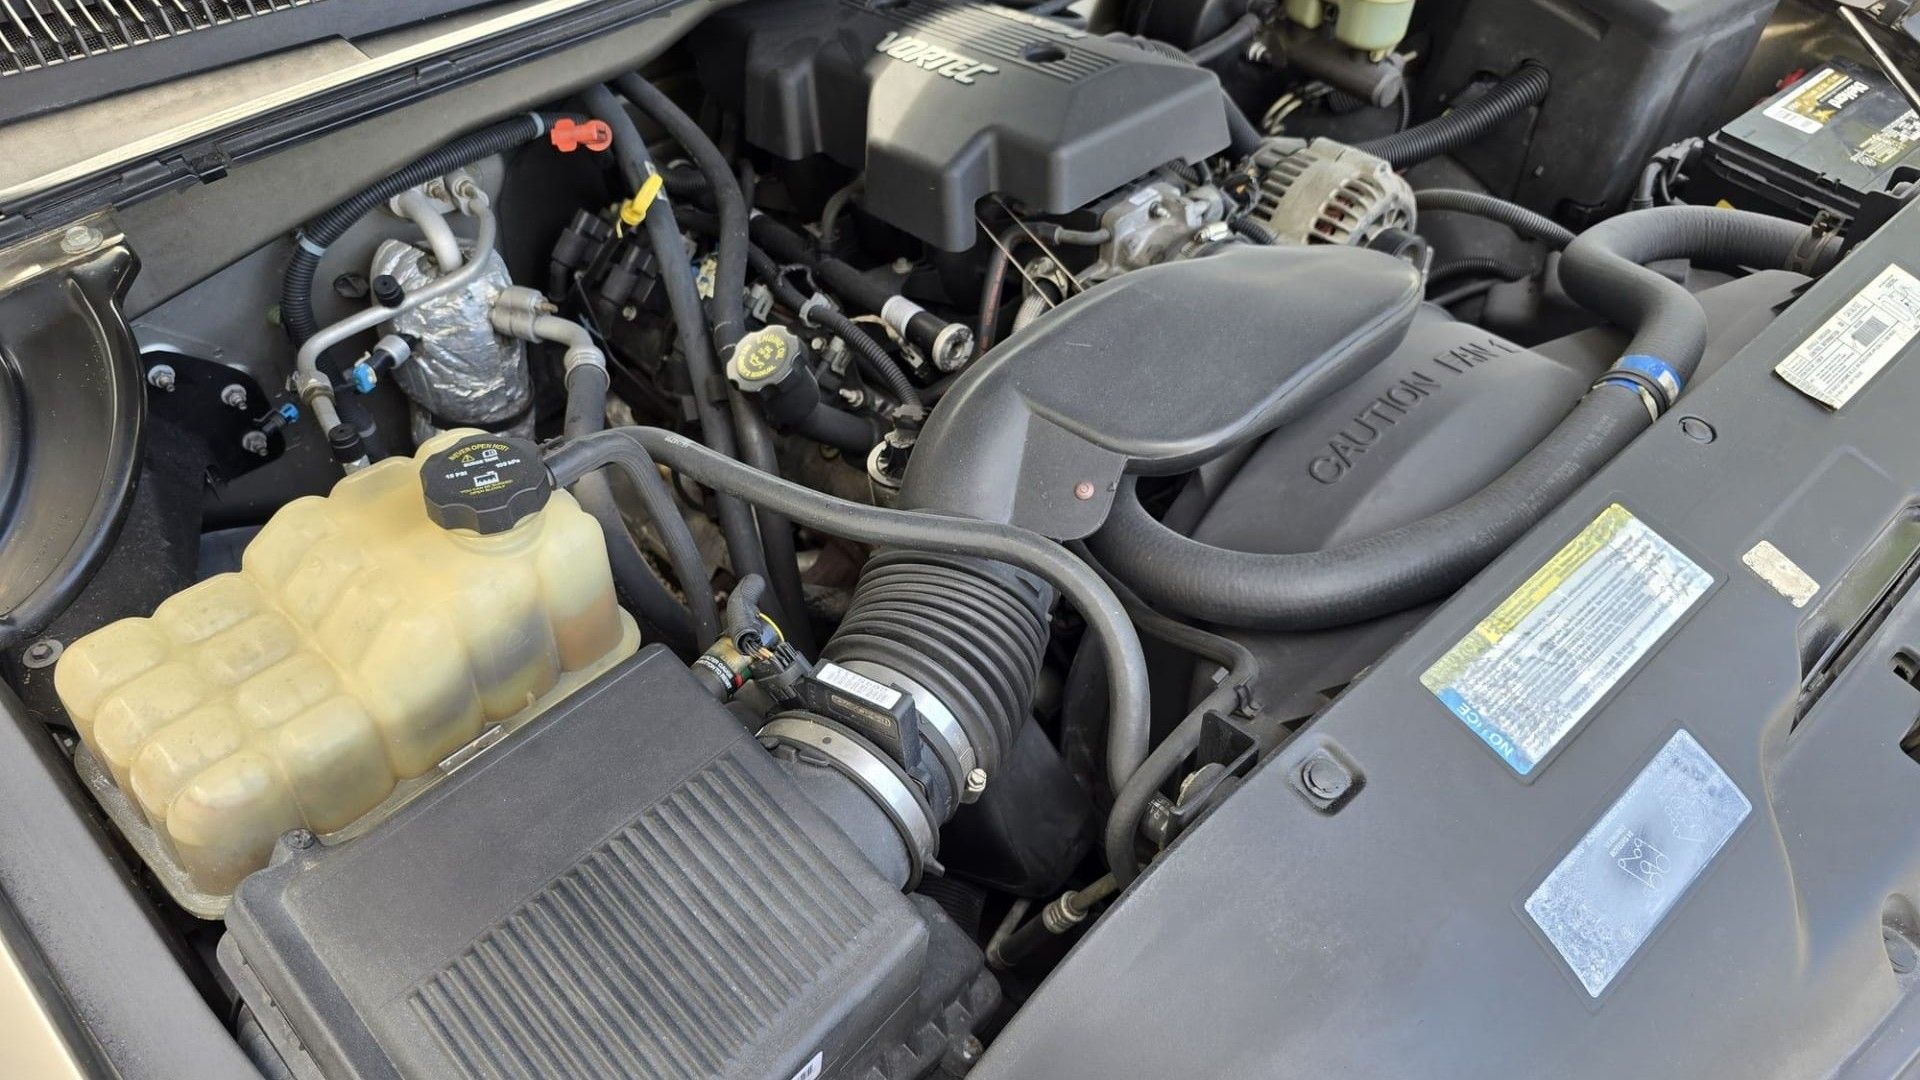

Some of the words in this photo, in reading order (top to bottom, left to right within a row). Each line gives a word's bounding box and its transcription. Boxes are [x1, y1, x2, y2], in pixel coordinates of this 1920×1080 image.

[876, 31, 1000, 85] VORTEC
[1308, 371, 1442, 485] CAUTION
[1433, 343, 1498, 374] FAN
[1456, 702, 1514, 757] NOICE
